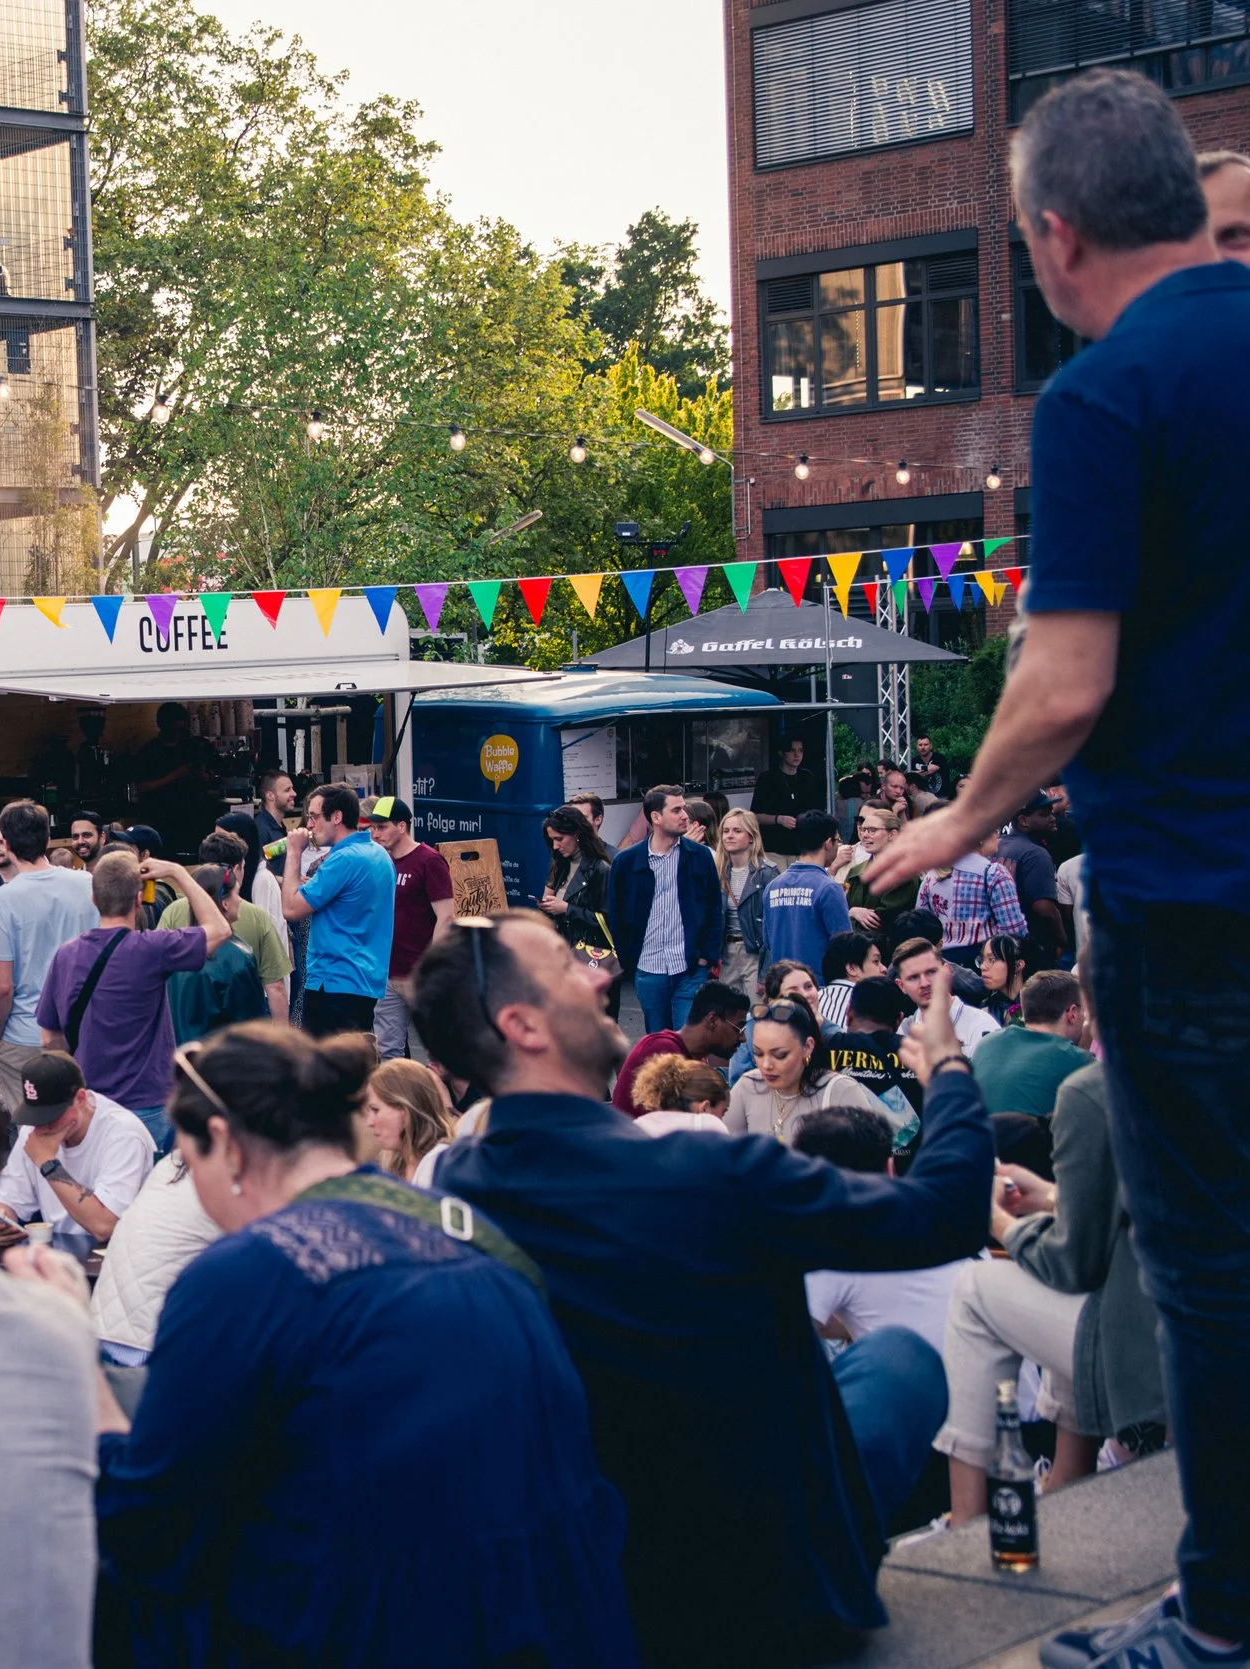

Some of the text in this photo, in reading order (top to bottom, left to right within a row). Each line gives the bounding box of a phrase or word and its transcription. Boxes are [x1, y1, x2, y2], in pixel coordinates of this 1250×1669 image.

[139, 614, 229, 653] COFFEE
[701, 636, 863, 652] Gaffel Kölsch
[484, 744, 515, 758] Bubble
[485, 760, 513, 774] Waffle
[426, 812, 456, 833] folge
[459, 815, 482, 833] mir!
